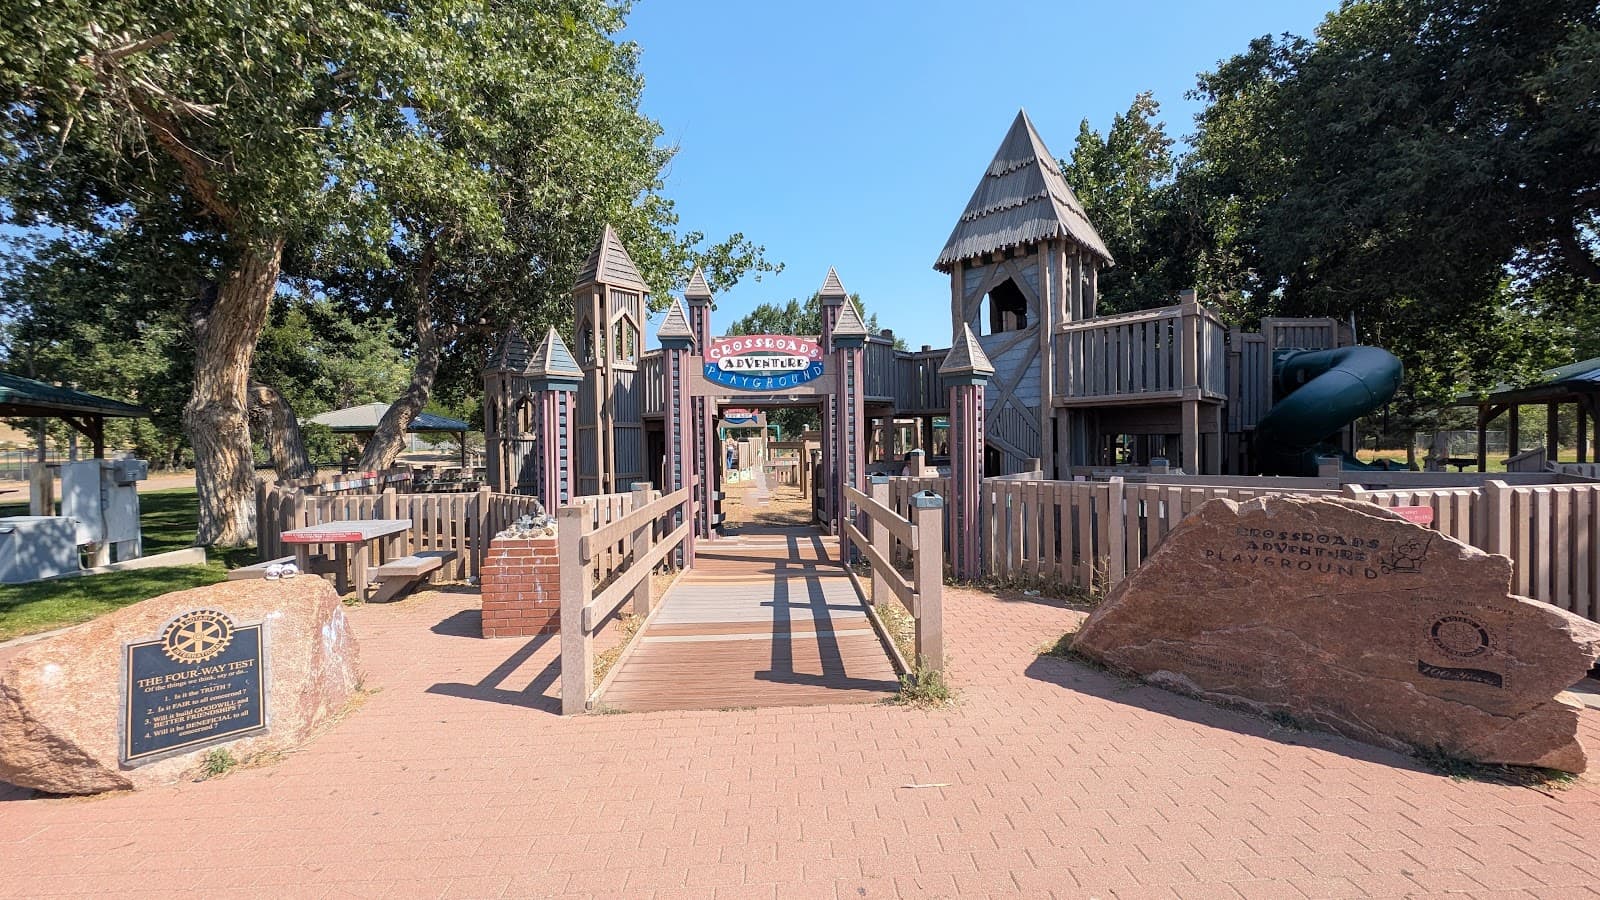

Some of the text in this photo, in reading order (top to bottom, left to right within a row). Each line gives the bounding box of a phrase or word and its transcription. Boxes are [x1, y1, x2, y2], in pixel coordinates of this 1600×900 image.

[710, 337, 819, 359] CROSSROADS
[724, 357, 803, 369] ADVENTURE
[707, 366, 821, 388] PLAYGROUND
[1236, 528, 1380, 549] CROSSROADS
[1246, 541, 1367, 562] ADVENTURE
[1206, 550, 1378, 580] PLAYGROUND
[137, 659, 255, 688] THE FOUR-WAY TEST
[166, 681, 187, 690] things
[200, 685, 226, 695] TRUTH
[172, 700, 192, 709] FAIR
[209, 689, 242, 701] concerned
[153, 714, 169, 722] Will
[193, 700, 237, 714] GOODWILL
[153, 717, 186, 729] BETTER
[186, 705, 237, 721] FRIENDSHIPS
[153, 728, 169, 737] Will
[185, 714, 233, 729] BENEFICIAL
